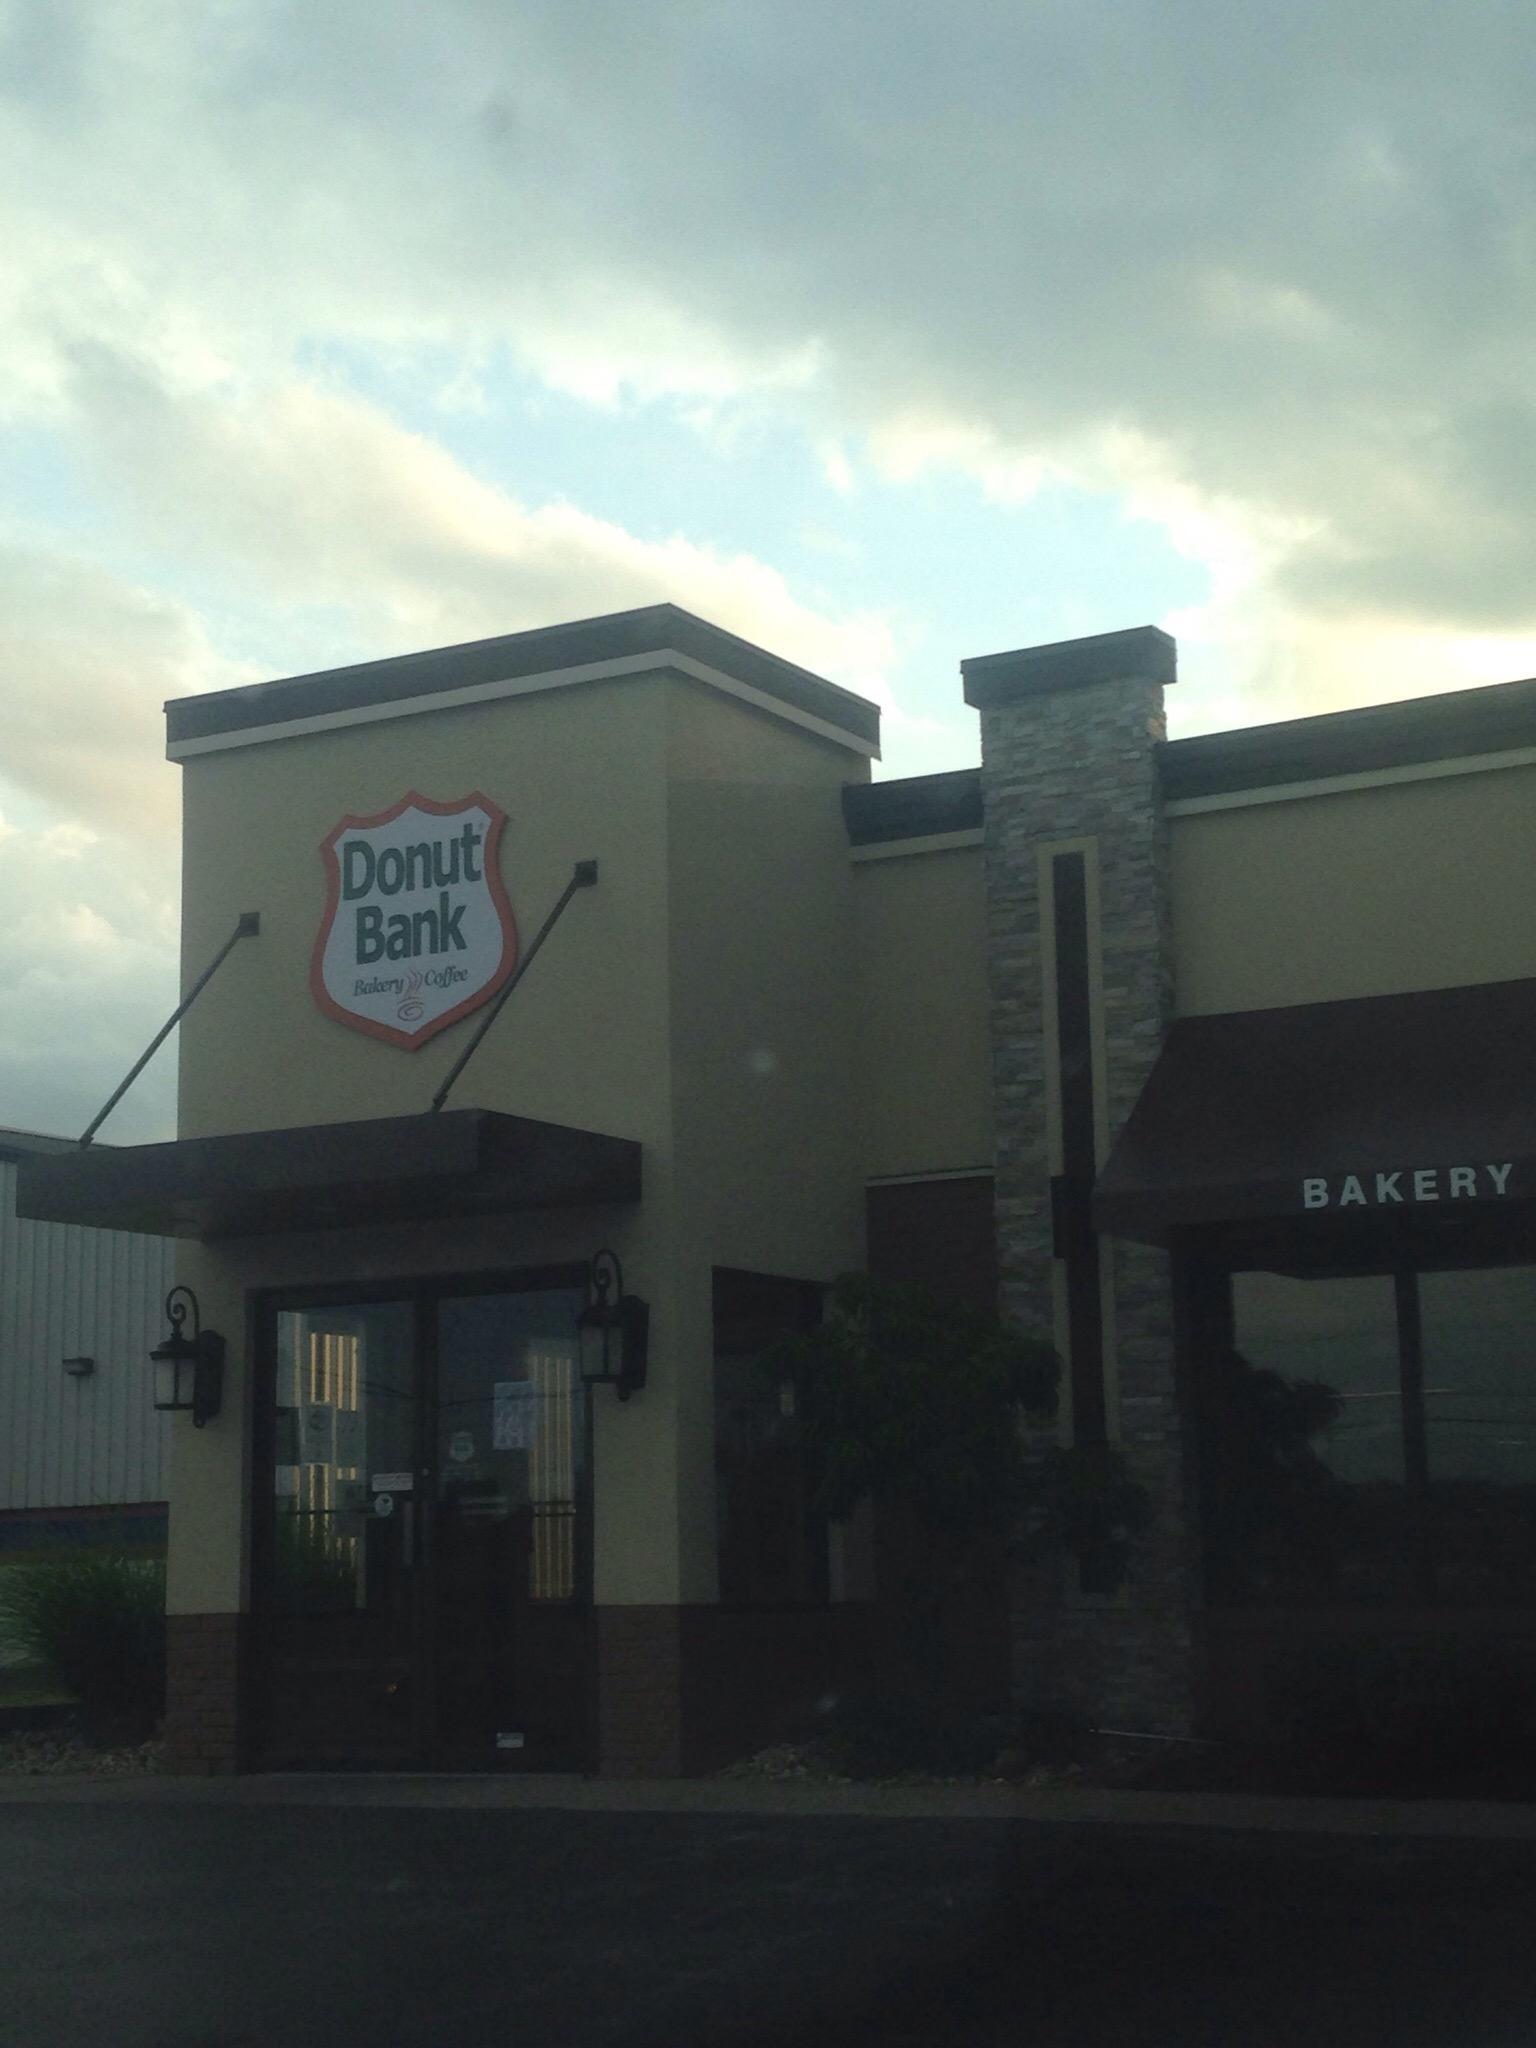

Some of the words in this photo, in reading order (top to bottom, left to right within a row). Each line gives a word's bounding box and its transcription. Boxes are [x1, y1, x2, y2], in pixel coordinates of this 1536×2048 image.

[343, 823, 482, 901] Donut
[356, 892, 468, 965] Bank
[354, 977, 404, 997] Bakery
[424, 965, 469, 989] Coffee
[1303, 1163, 1513, 1209] BAKERY
